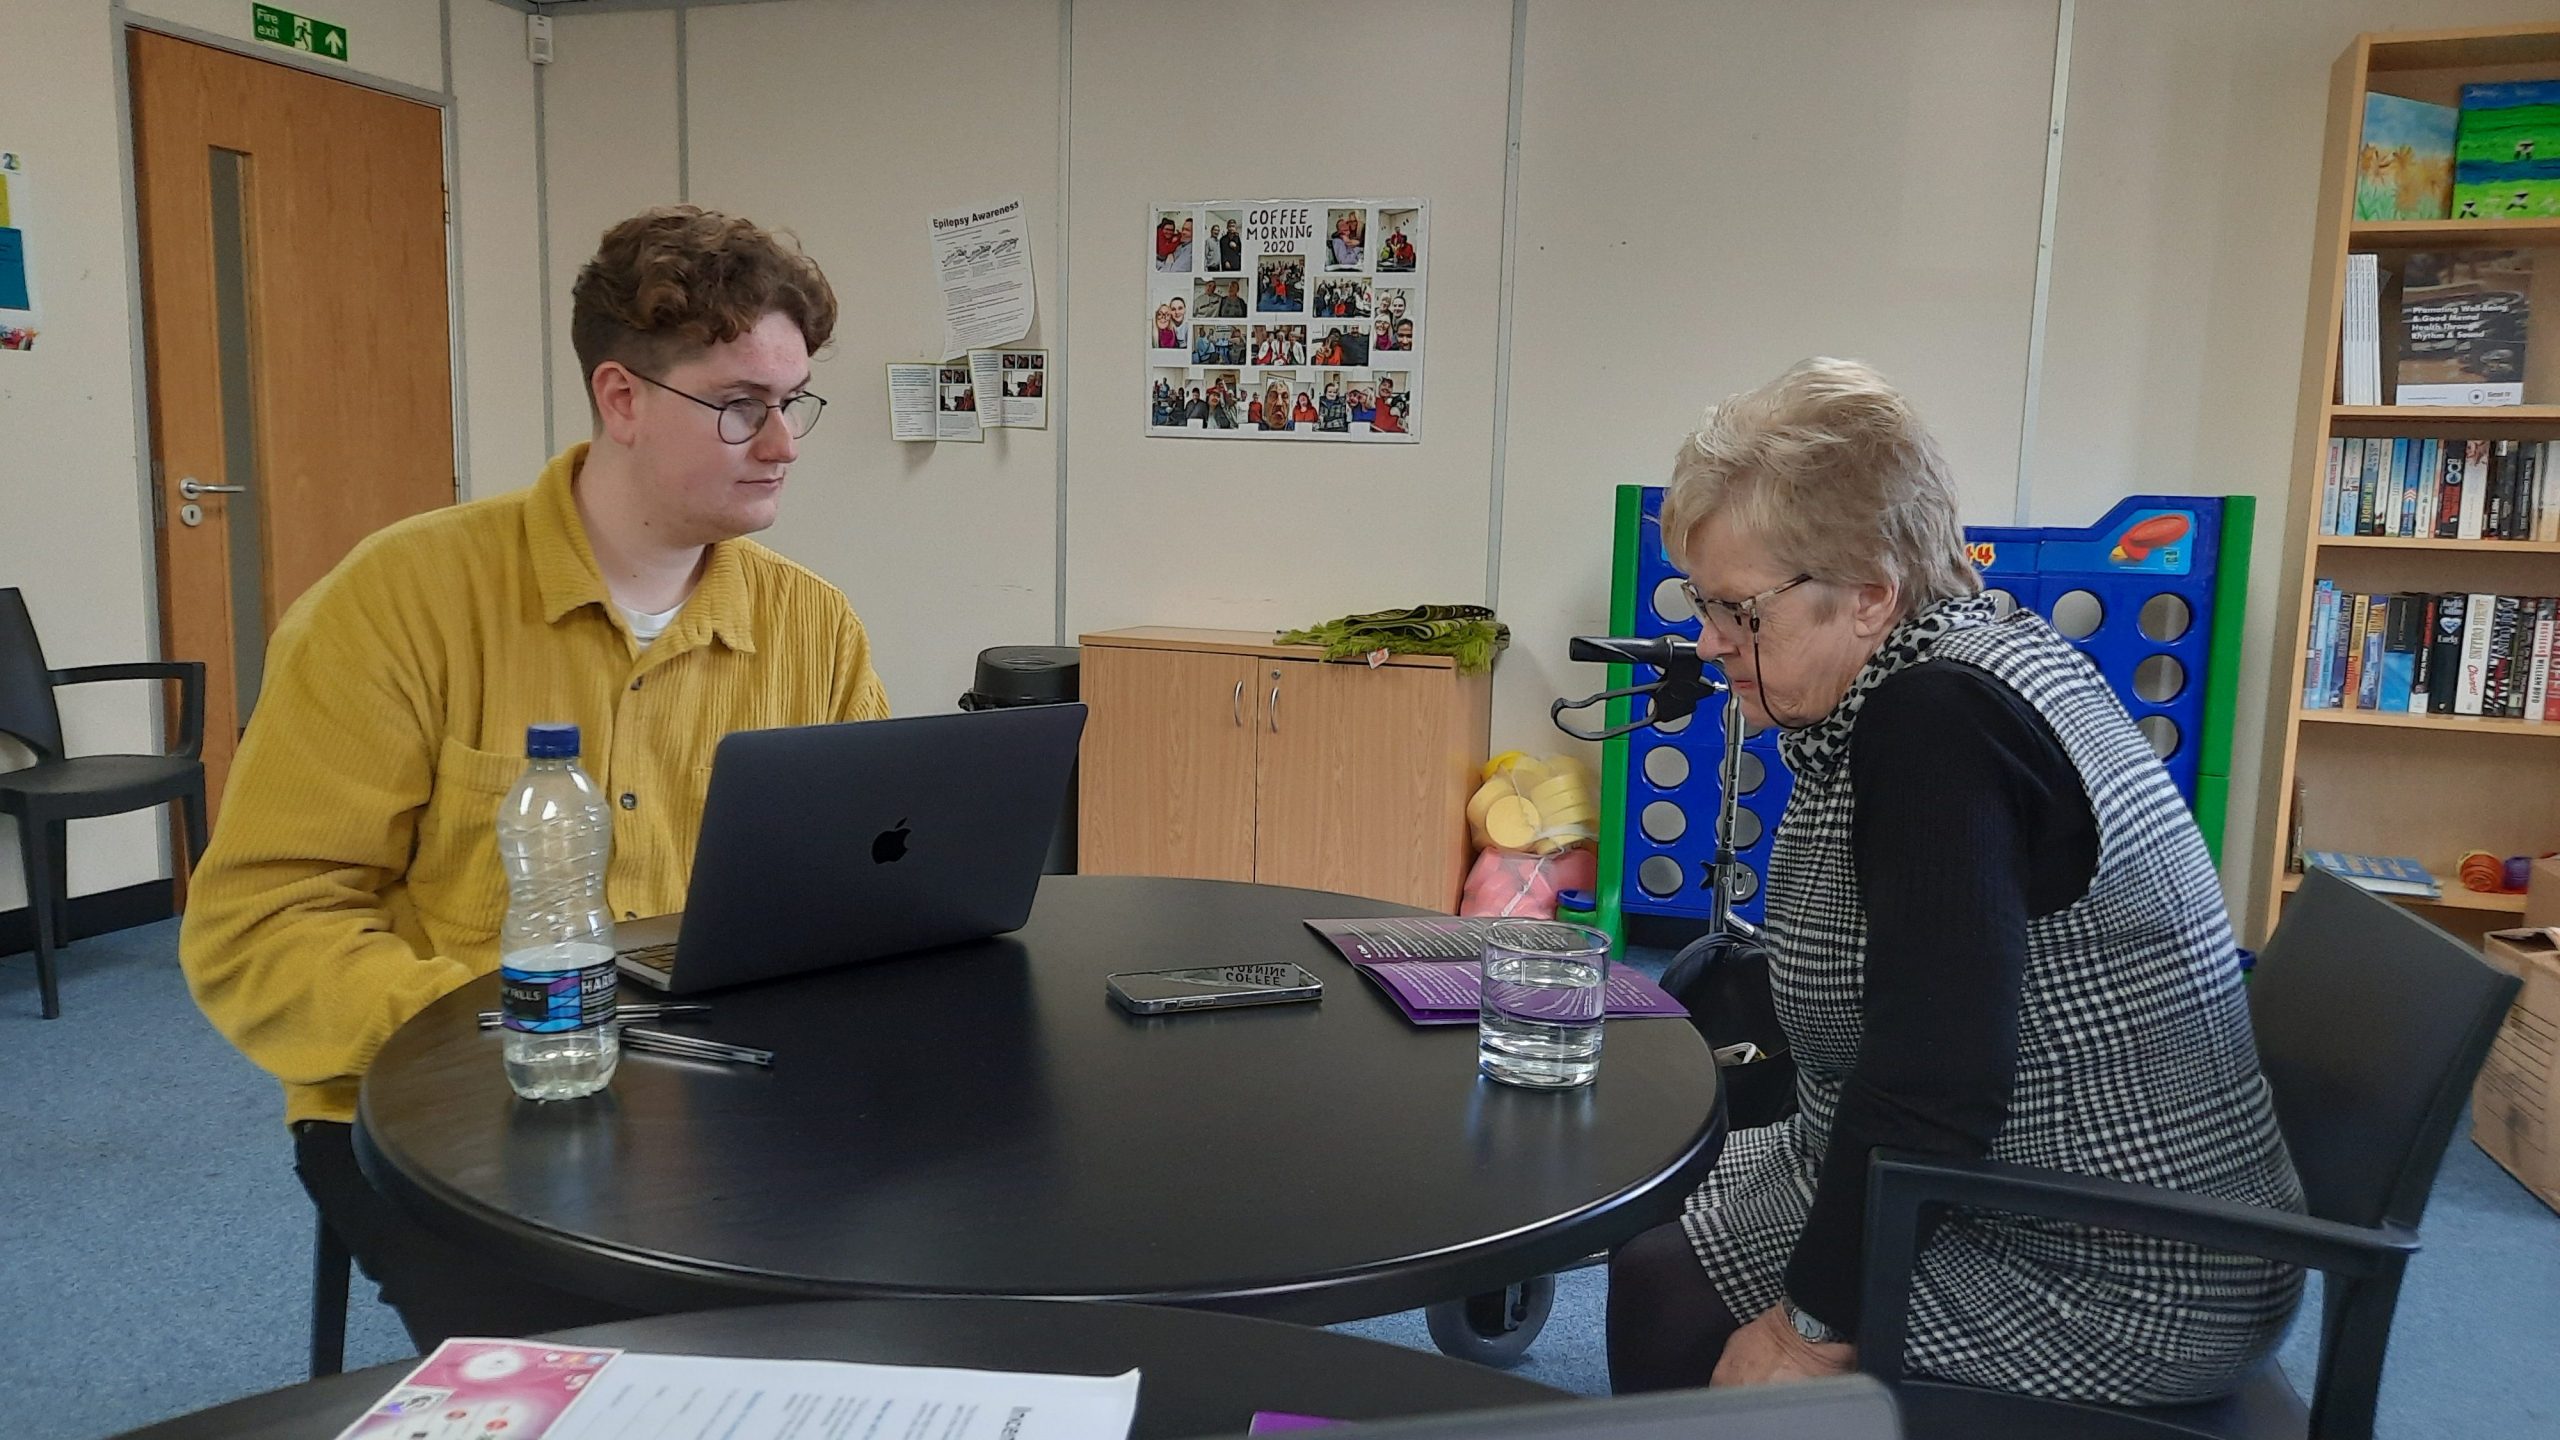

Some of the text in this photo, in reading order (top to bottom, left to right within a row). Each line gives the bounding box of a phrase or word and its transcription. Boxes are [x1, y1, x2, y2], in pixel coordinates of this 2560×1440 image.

[256, 8, 279, 24] Fire
[257, 25, 280, 39] exit
[933, 200, 1020, 231] Epilepsy Awareness
[1249, 208, 1309, 225] COFFEE
[1246, 224, 1313, 241] MORNING
[1263, 240, 1295, 253] 2020
[2421, 314, 2448, 322] Good
[2411, 323, 2442, 332] Health
[2456, 330, 2486, 339] Sound
